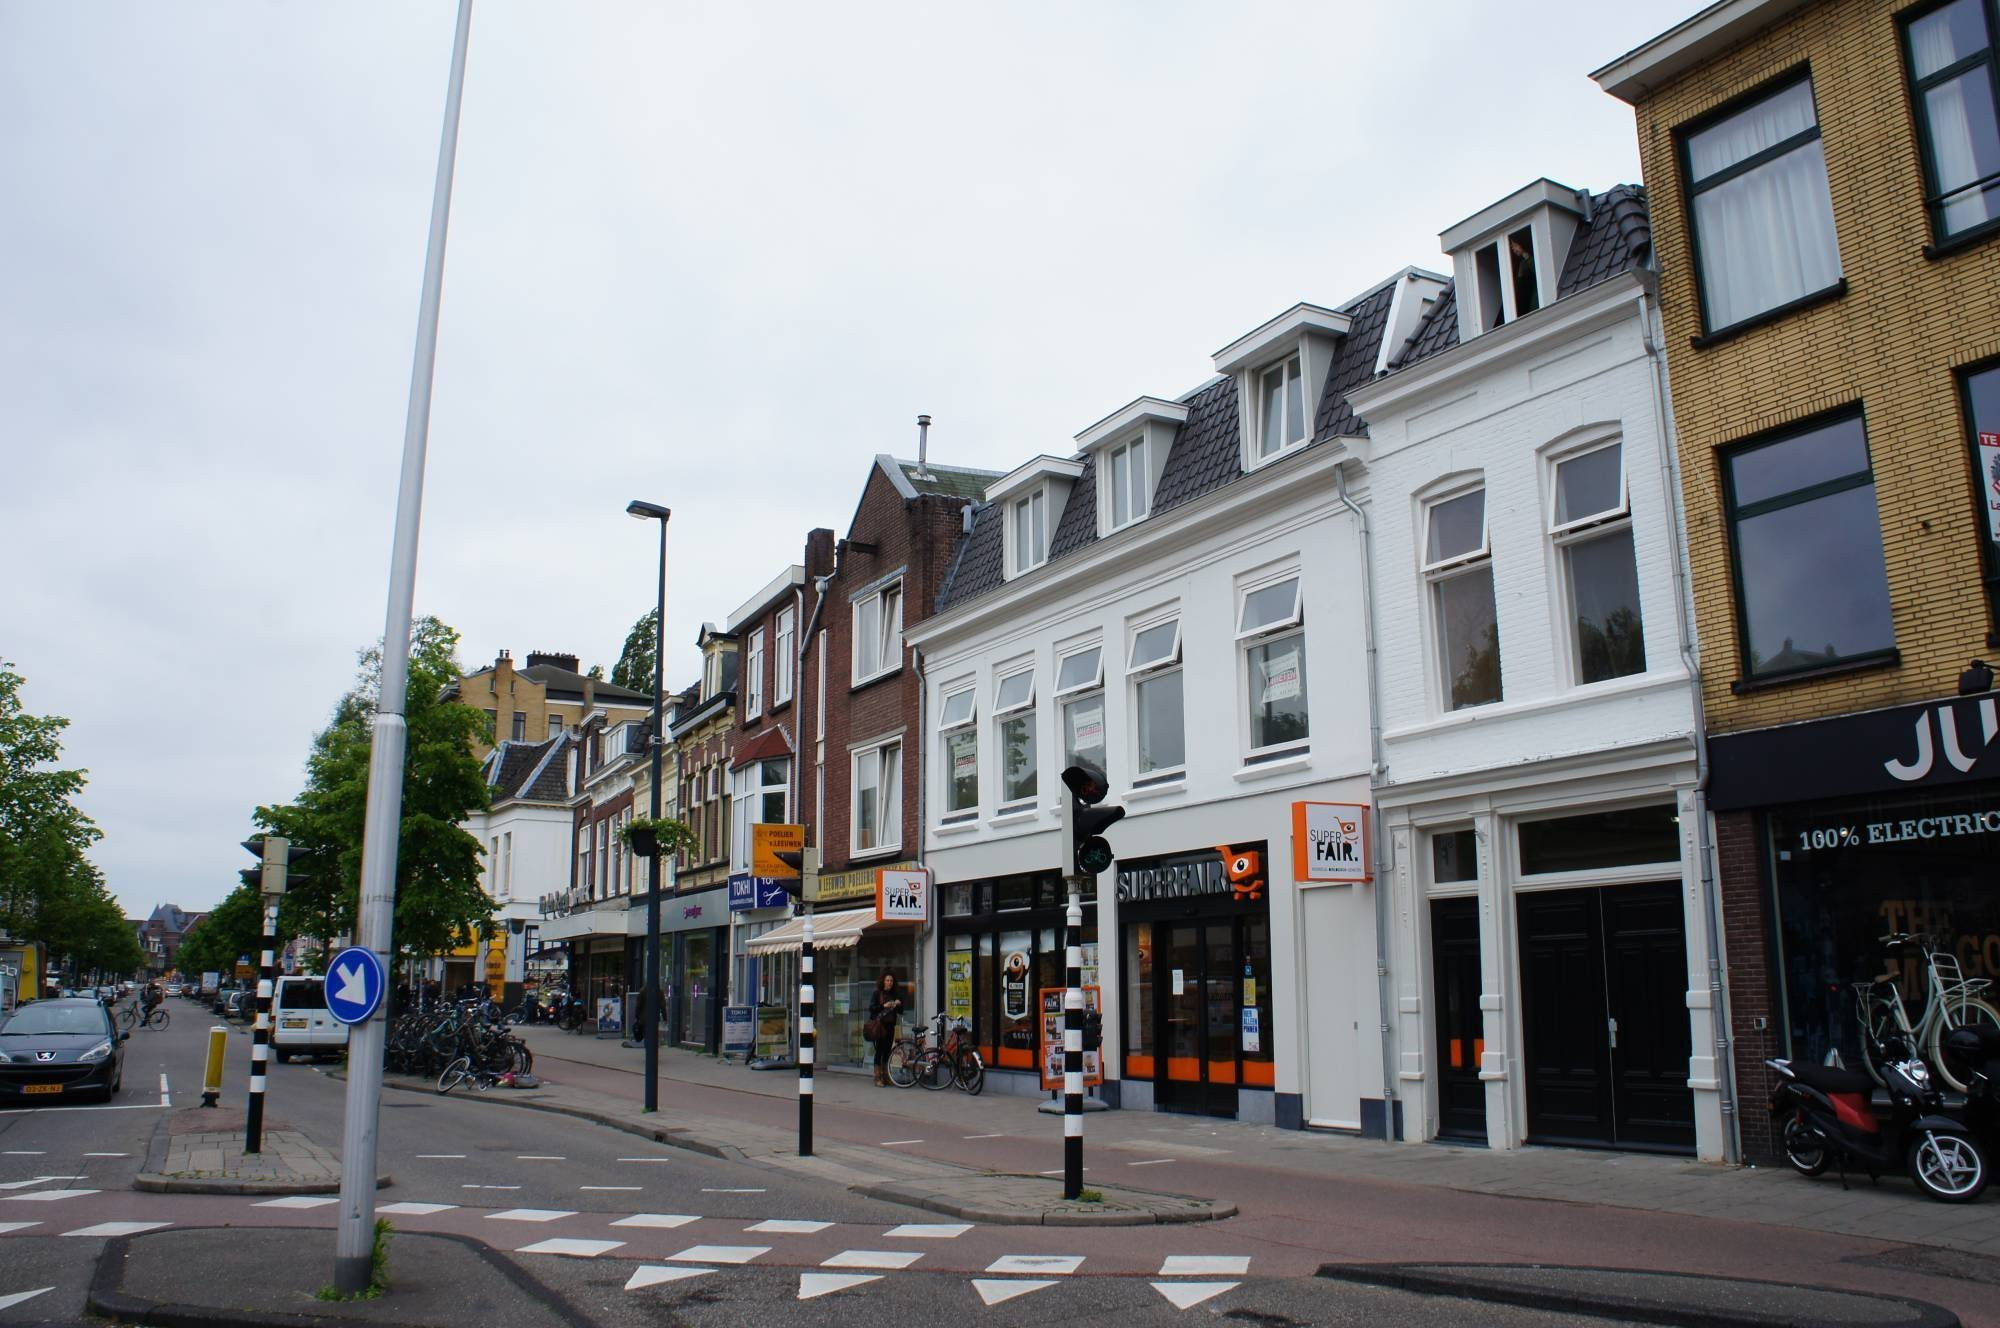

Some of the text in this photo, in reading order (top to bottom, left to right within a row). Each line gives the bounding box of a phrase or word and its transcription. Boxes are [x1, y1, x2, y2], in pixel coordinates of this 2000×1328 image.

[1310, 829, 1342, 846] SUPER
[1800, 826, 1860, 850] 100%
[1316, 841, 1359, 862] FAIR.
[732, 879, 751, 897] TOKHI
[884, 886, 910, 897] SUPER
[889, 895, 922, 909] FAIR.
